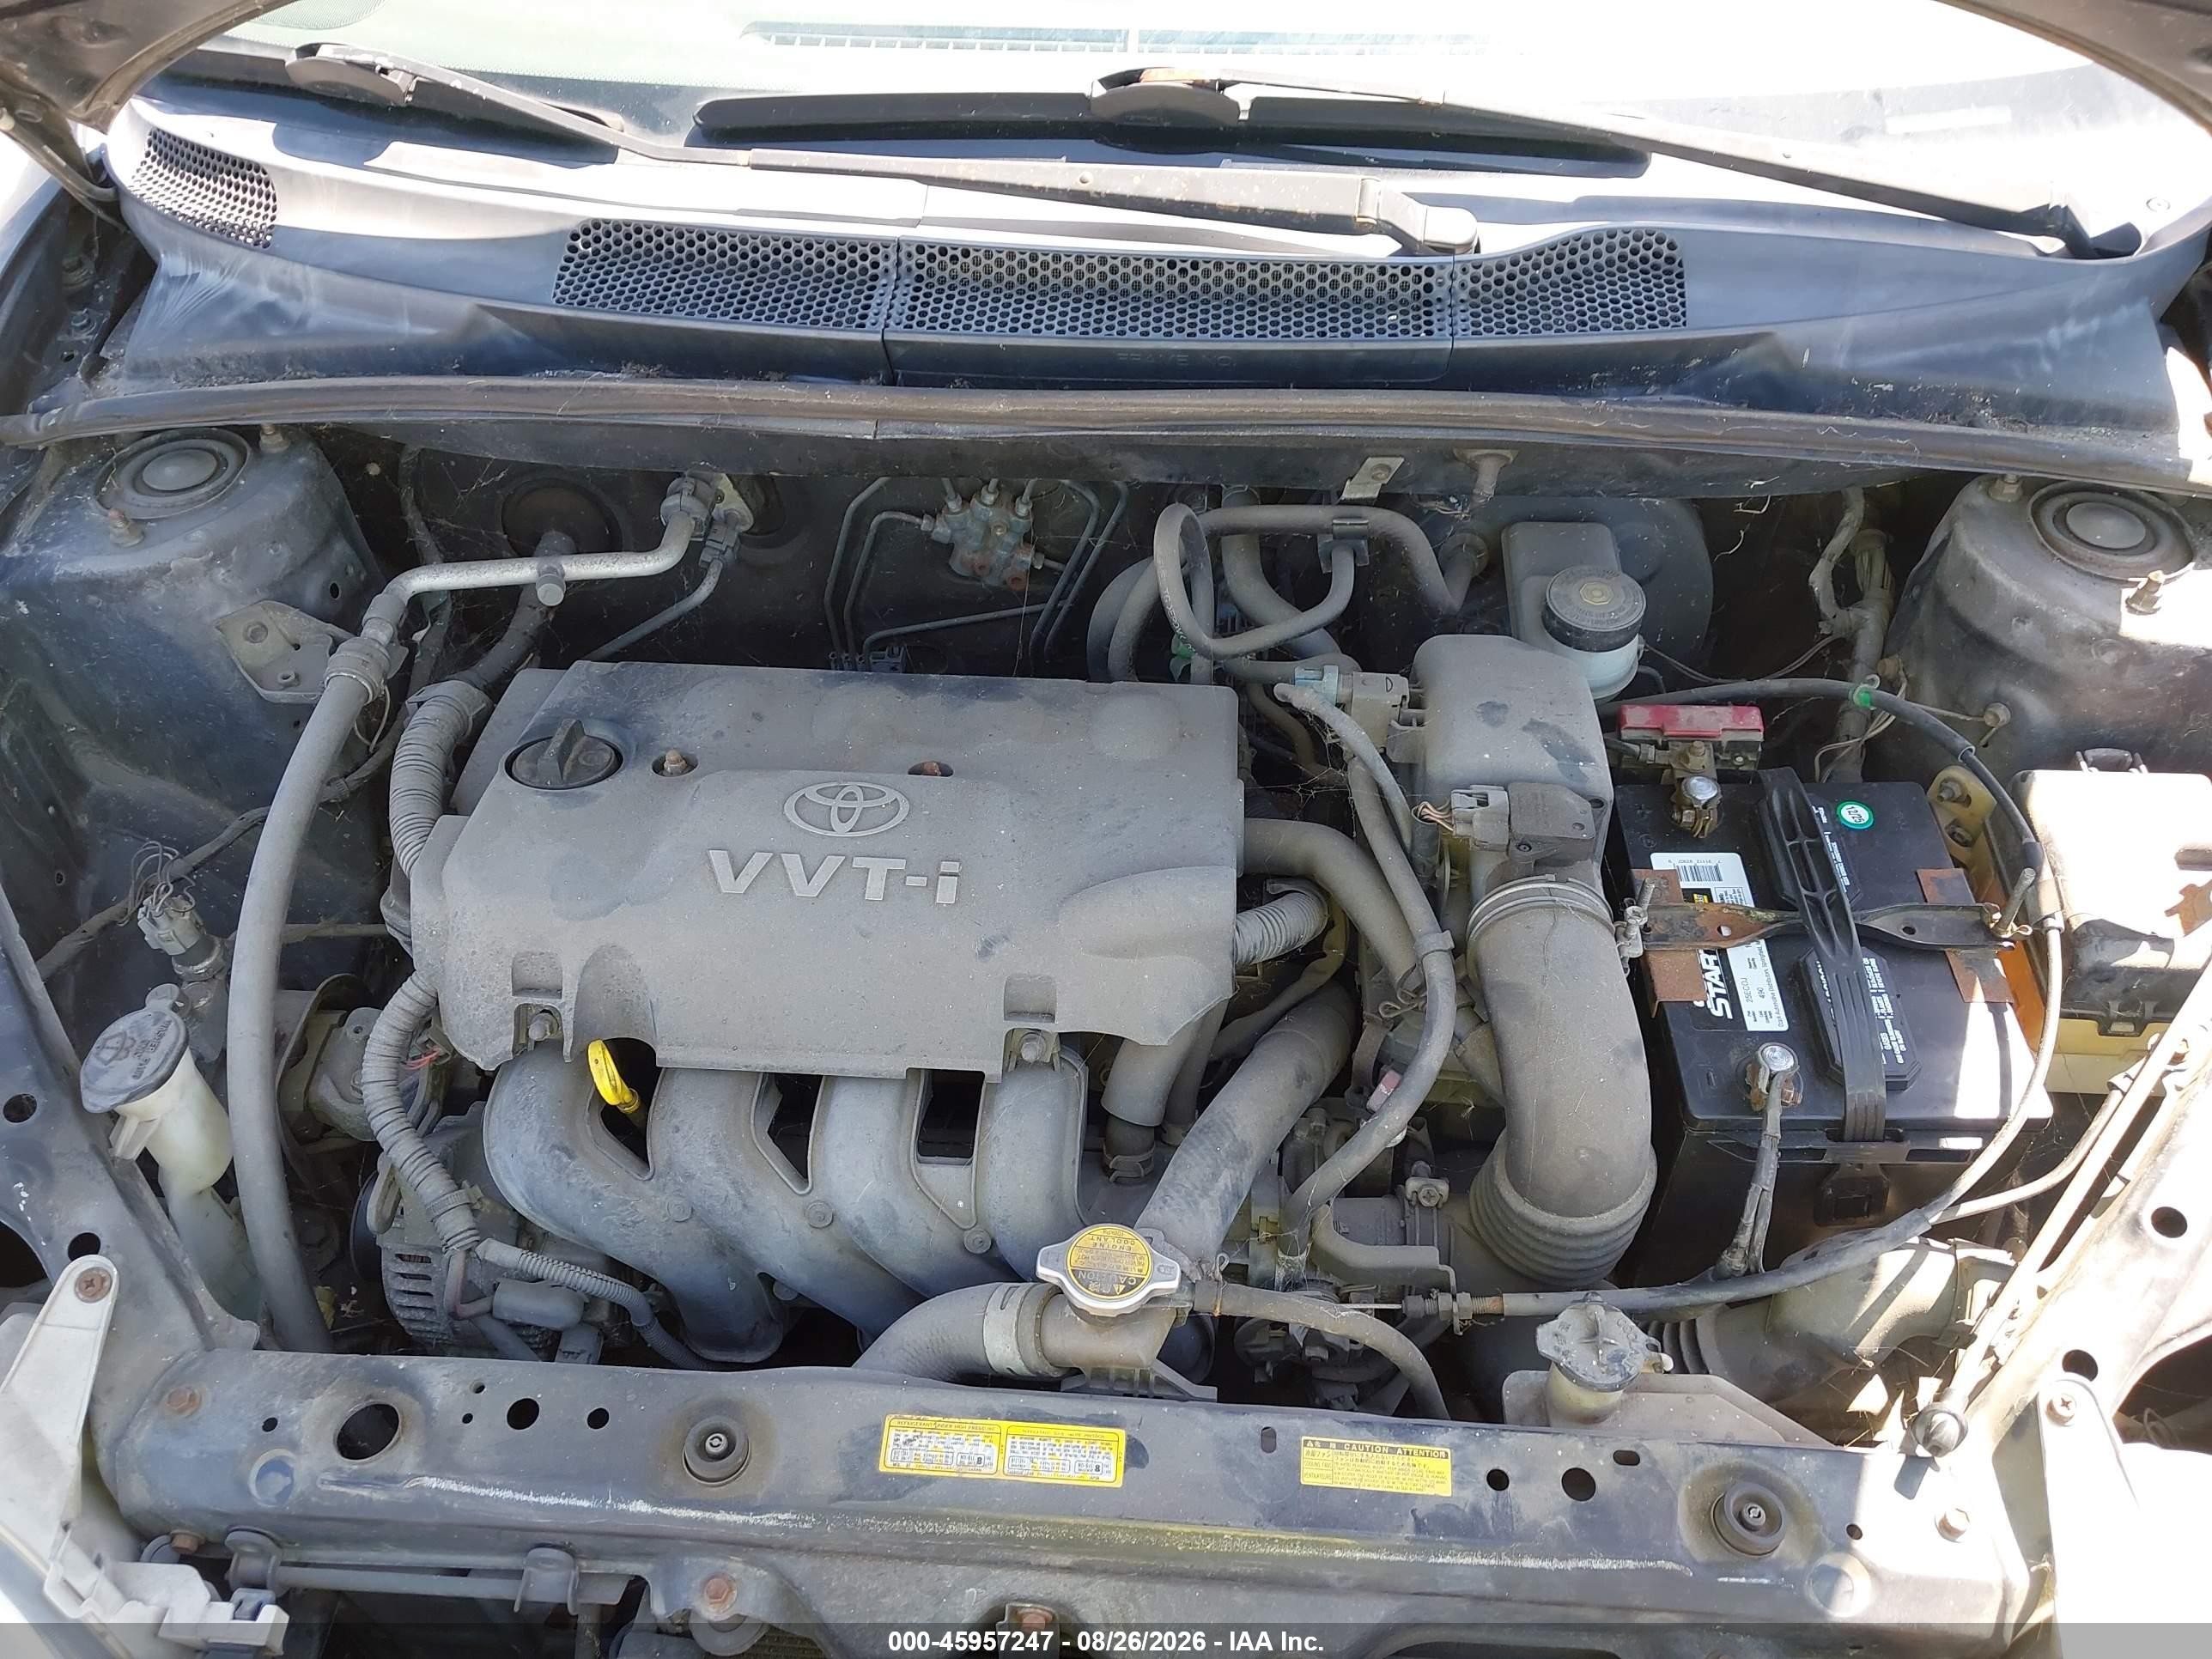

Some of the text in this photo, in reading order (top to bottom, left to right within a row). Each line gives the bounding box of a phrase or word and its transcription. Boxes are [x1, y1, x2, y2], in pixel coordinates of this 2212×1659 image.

[1385, 676, 1394, 693] D
[1845, 805, 1865, 823] 12/25
[708, 849, 963, 904] VVT-i
[1756, 987, 1765, 1000] 490
[1090, 1236, 1135, 1246] COOLANT
[1091, 1242, 1133, 1252] ENGINE
[1078, 1271, 1137, 1285] CAUTION
[1344, 1443, 1389, 1454] CAUTION
[1396, 1447, 1446, 1458] ATTENTION
